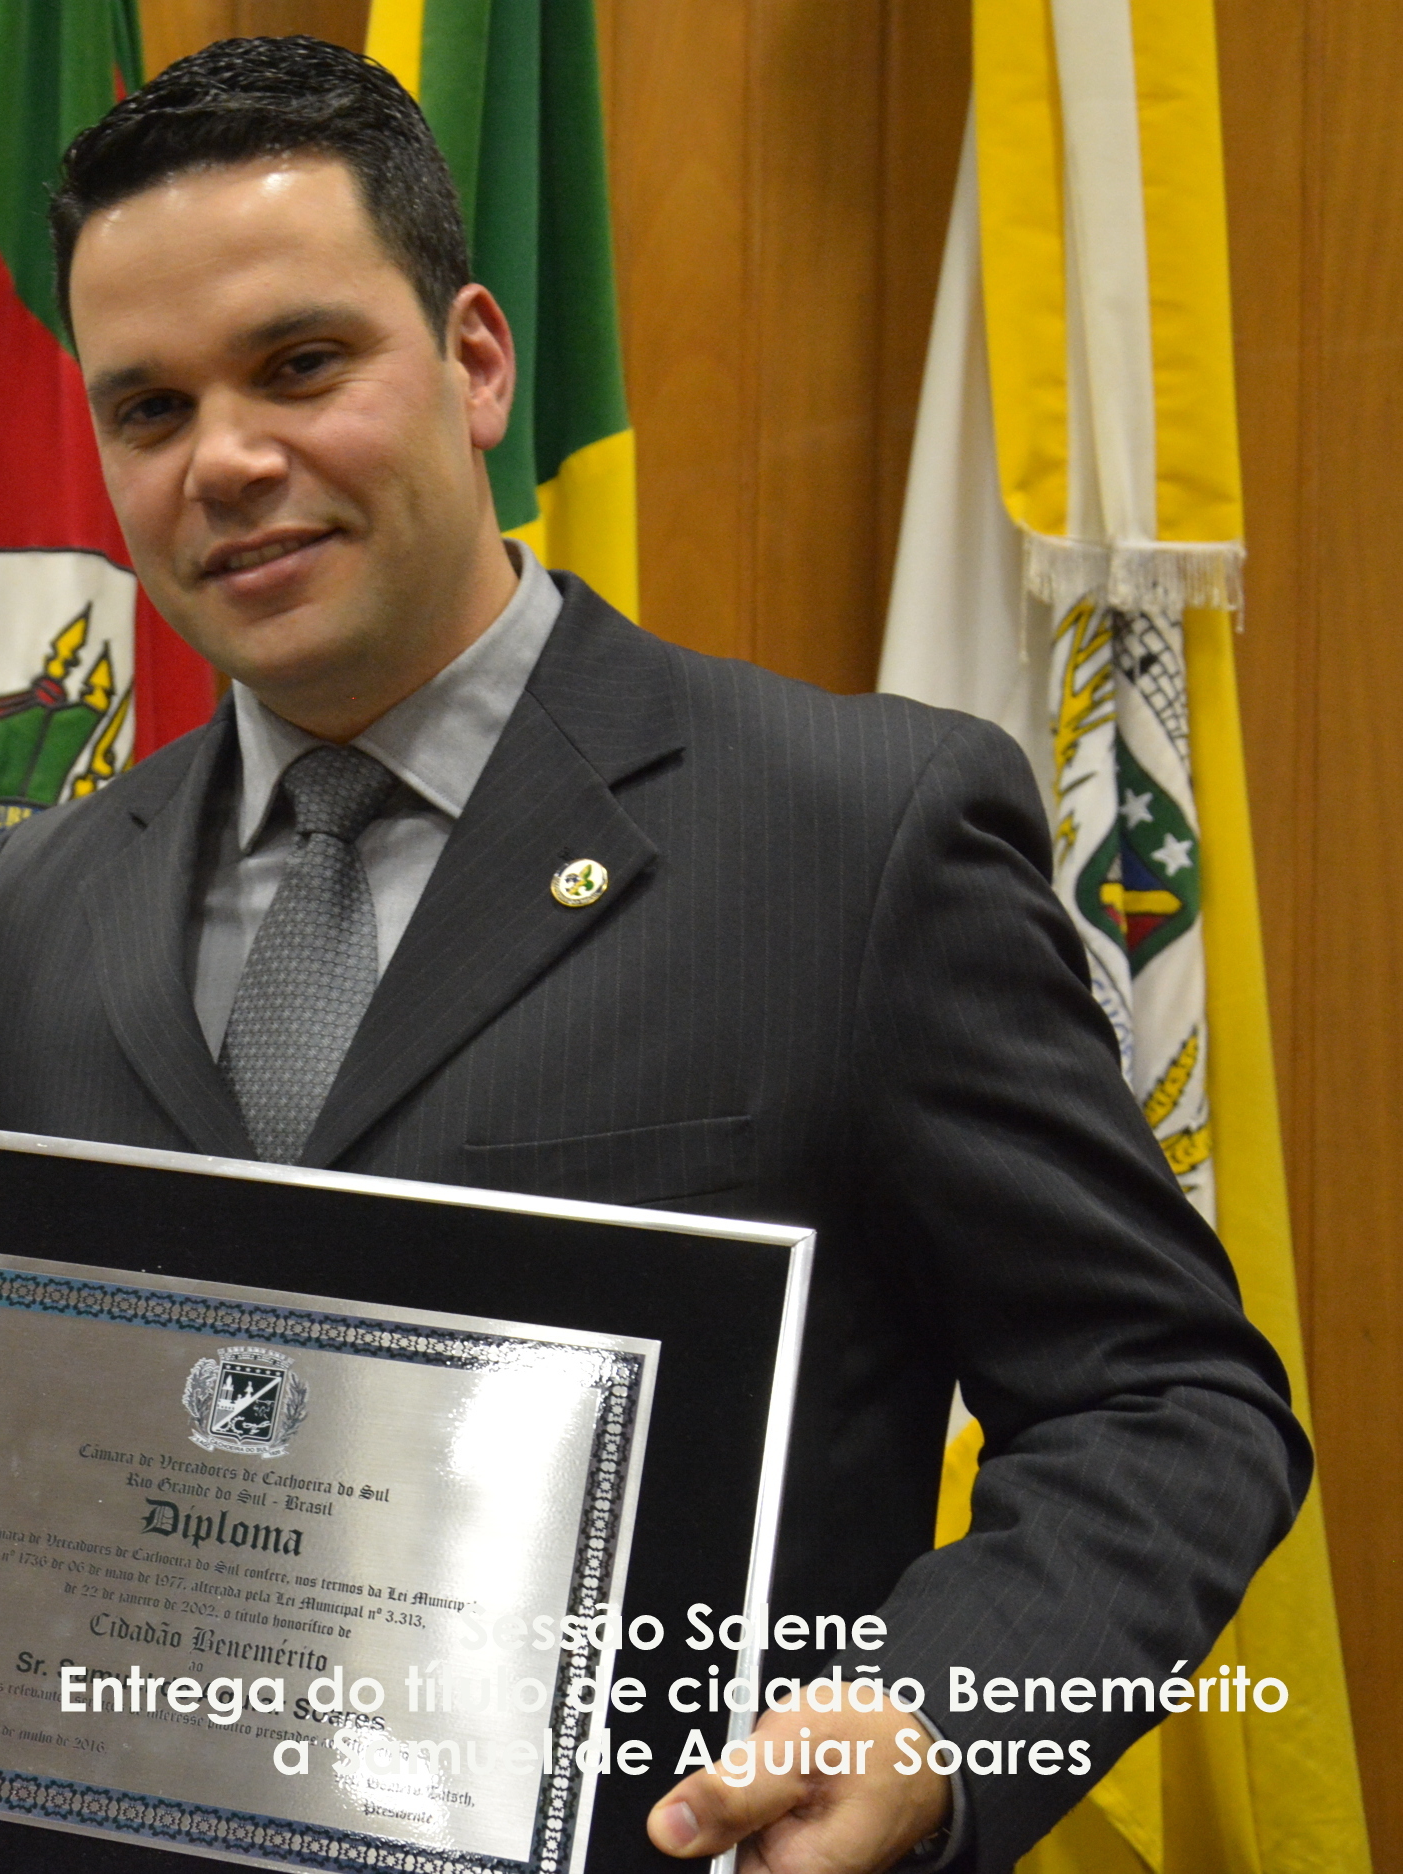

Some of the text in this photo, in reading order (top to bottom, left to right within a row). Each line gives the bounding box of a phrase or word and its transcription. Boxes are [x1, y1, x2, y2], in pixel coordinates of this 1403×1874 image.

[78, 1443, 390, 1503] Câmara de Vereadores de Cachoeira do Sul
[209, 1437, 244, 1453] CACHOEIRA
[126, 1472, 152, 1489] Rio
[157, 1476, 211, 1498] Grande
[215, 1486, 232, 1500] do
[236, 1488, 267, 1507] Sul
[284, 1494, 333, 1516] Brasil
[140, 1496, 305, 1557] Diploma
[18, 1552, 47, 1568] 1736
[50, 1557, 65, 1570] de
[68, 1560, 86, 1574] 06
[88, 1563, 102, 1577] de
[105, 1567, 134, 1584] maio
[137, 1571, 152, 1585] de
[190, 1579, 242, 1599] alterada
[244, 1588, 271, 1605] pela
[275, 1591, 296, 1607] Lei
[298, 1596, 364, 1619] Municipal
[385, 1609, 426, 1630] 3.313,
[28, 1532, 42, 1545] de
[46, 1532, 112, 1557] Vereadores
[115, 1545, 129, 1559] de
[132, 1547, 192, 1569] Cachoeira
[195, 1558, 210, 1572] do
[213, 1560, 240, 1577] Sul
[244, 1566, 291, 1586] confere,
[295, 1573, 317, 1588] nos
[321, 1577, 364, 1596] termos
[367, 1584, 383, 1599] da
[386, 1586, 410, 1602] Lei
[63, 1581, 78, 1595] de
[80, 1584, 99, 1598] 22
[101, 1587, 115, 1601] de
[118, 1590, 160, 1610] janeiro
[163, 1598, 177, 1612] de
[223, 1608, 231, 1620] o
[234, 1605, 268, 1627] título
[272, 1614, 334, 1637] honorífico
[338, 1625, 352, 1640] de
[15, 1651, 48, 1677] Sr.
[89, 1612, 328, 1672] Cidadão Benemérito
[188, 1660, 204, 1673] ao
[2, 1723, 16, 1738] de
[55, 1734, 70, 1748] de
